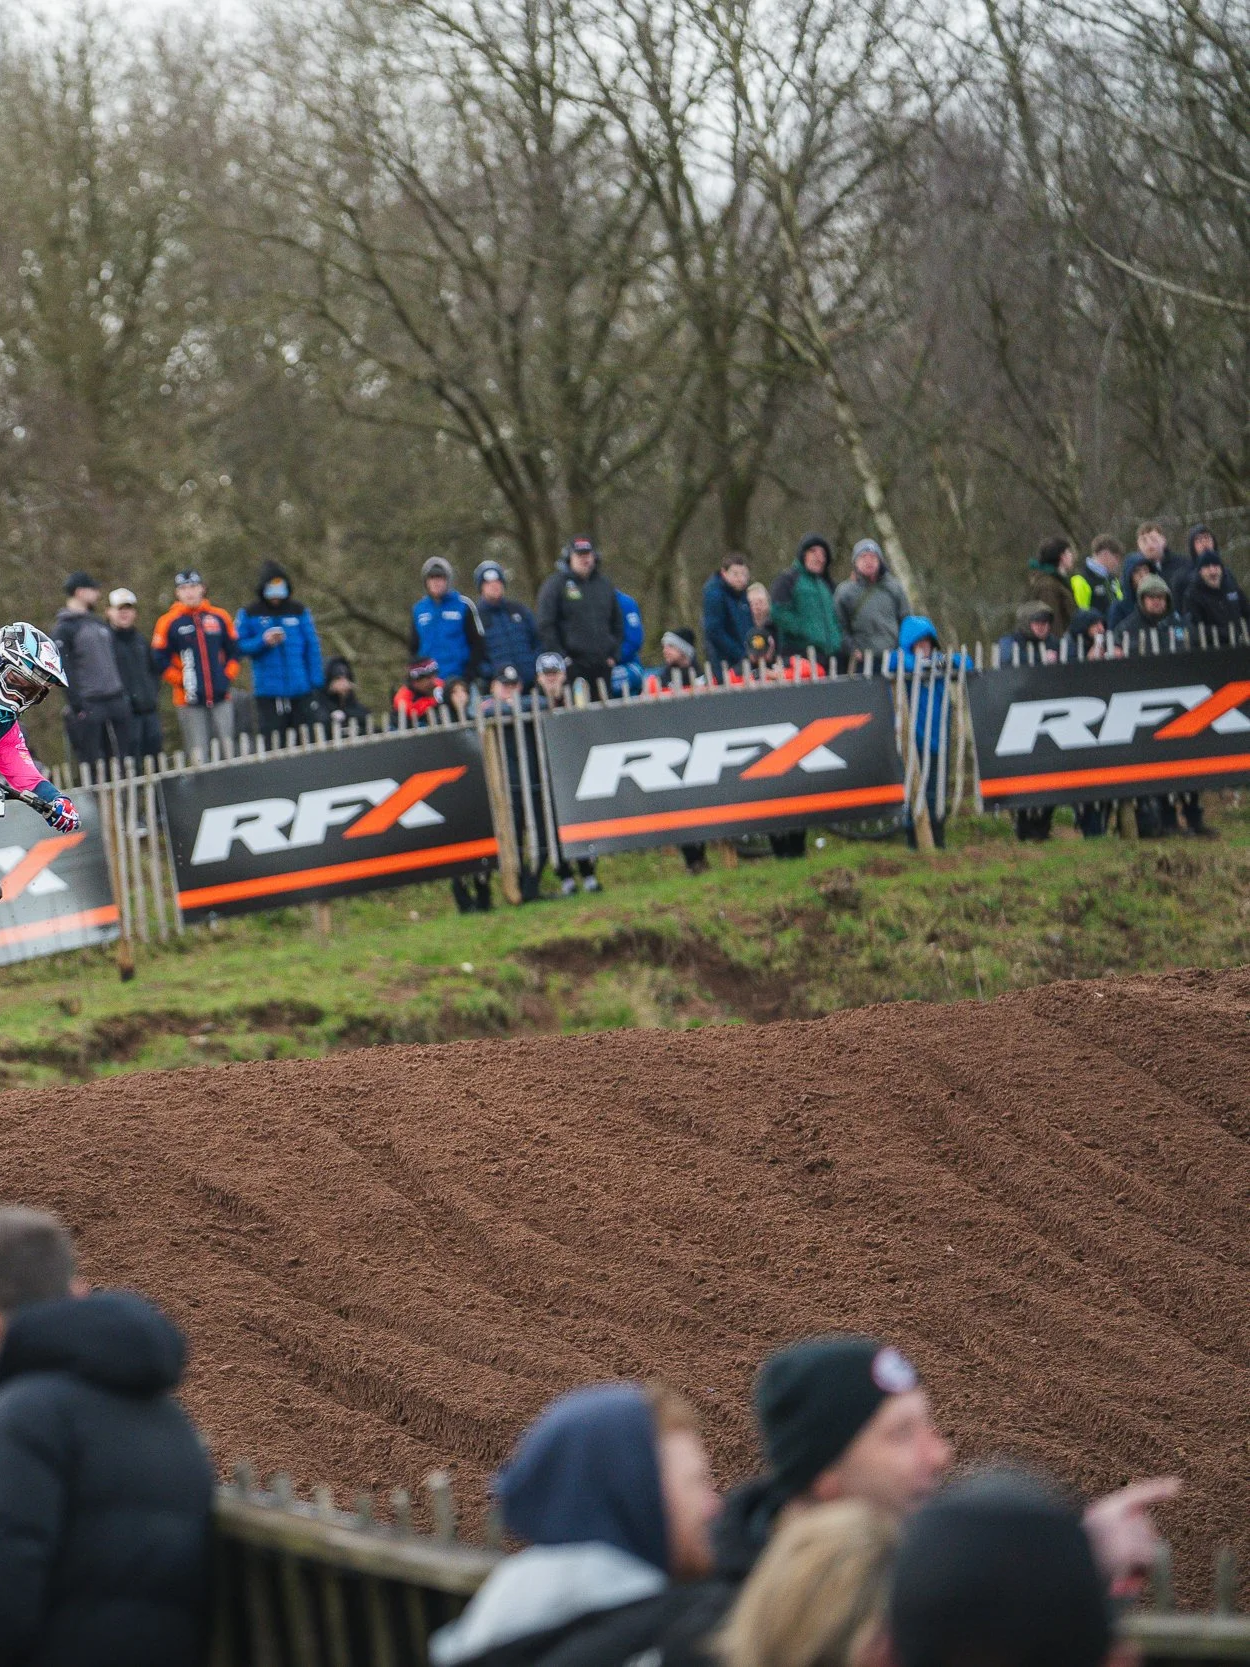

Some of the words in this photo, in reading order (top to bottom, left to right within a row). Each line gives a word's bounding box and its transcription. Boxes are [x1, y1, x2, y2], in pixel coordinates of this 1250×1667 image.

[575, 713, 873, 801] RFX
[995, 680, 1250, 757] RFX
[190, 765, 468, 866] RFX
